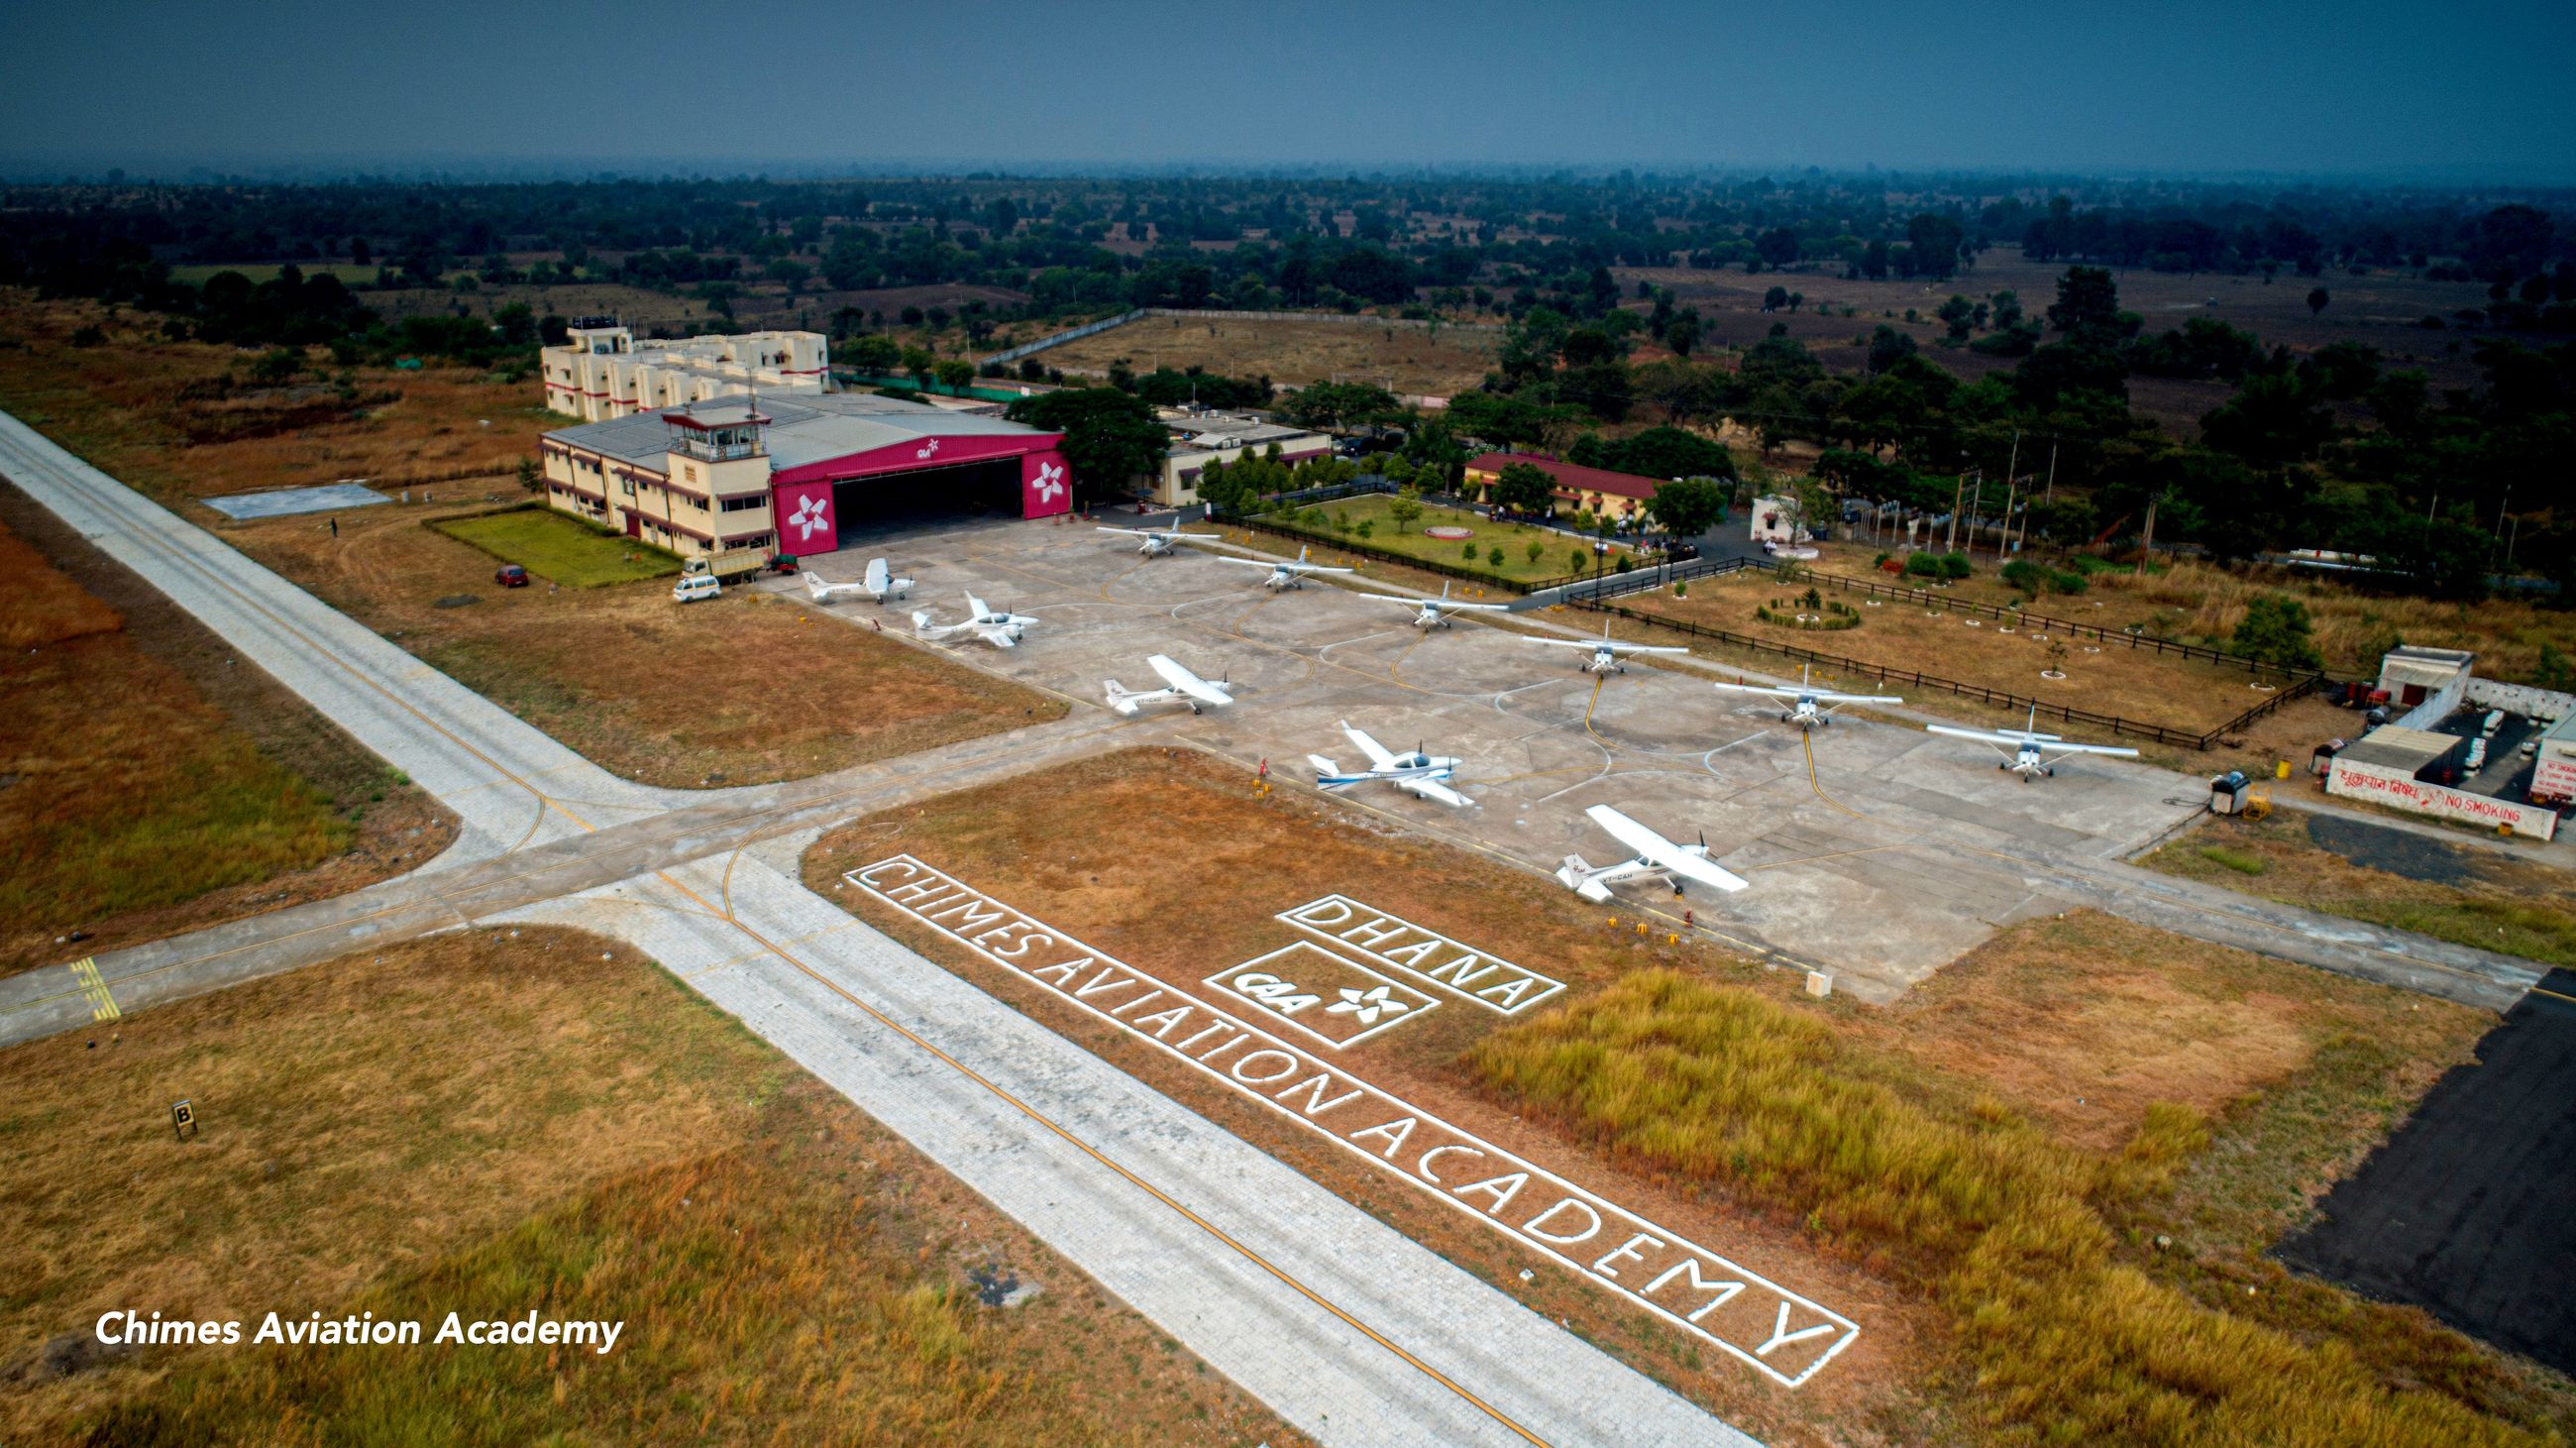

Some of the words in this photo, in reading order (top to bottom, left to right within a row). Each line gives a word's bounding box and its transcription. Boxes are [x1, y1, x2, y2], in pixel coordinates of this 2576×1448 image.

[2444, 795, 2462, 809] NO
[2464, 799, 2521, 822] SMOKING
[1602, 872, 1633, 883] VT-CAH
[1293, 899, 1535, 1007] DHANA
[176, 1106, 190, 1124] B
[859, 861, 1053, 956] CHIMES
[1033, 956, 1363, 1115] AVIATION
[1349, 1117, 1835, 1356] ACADEMY
